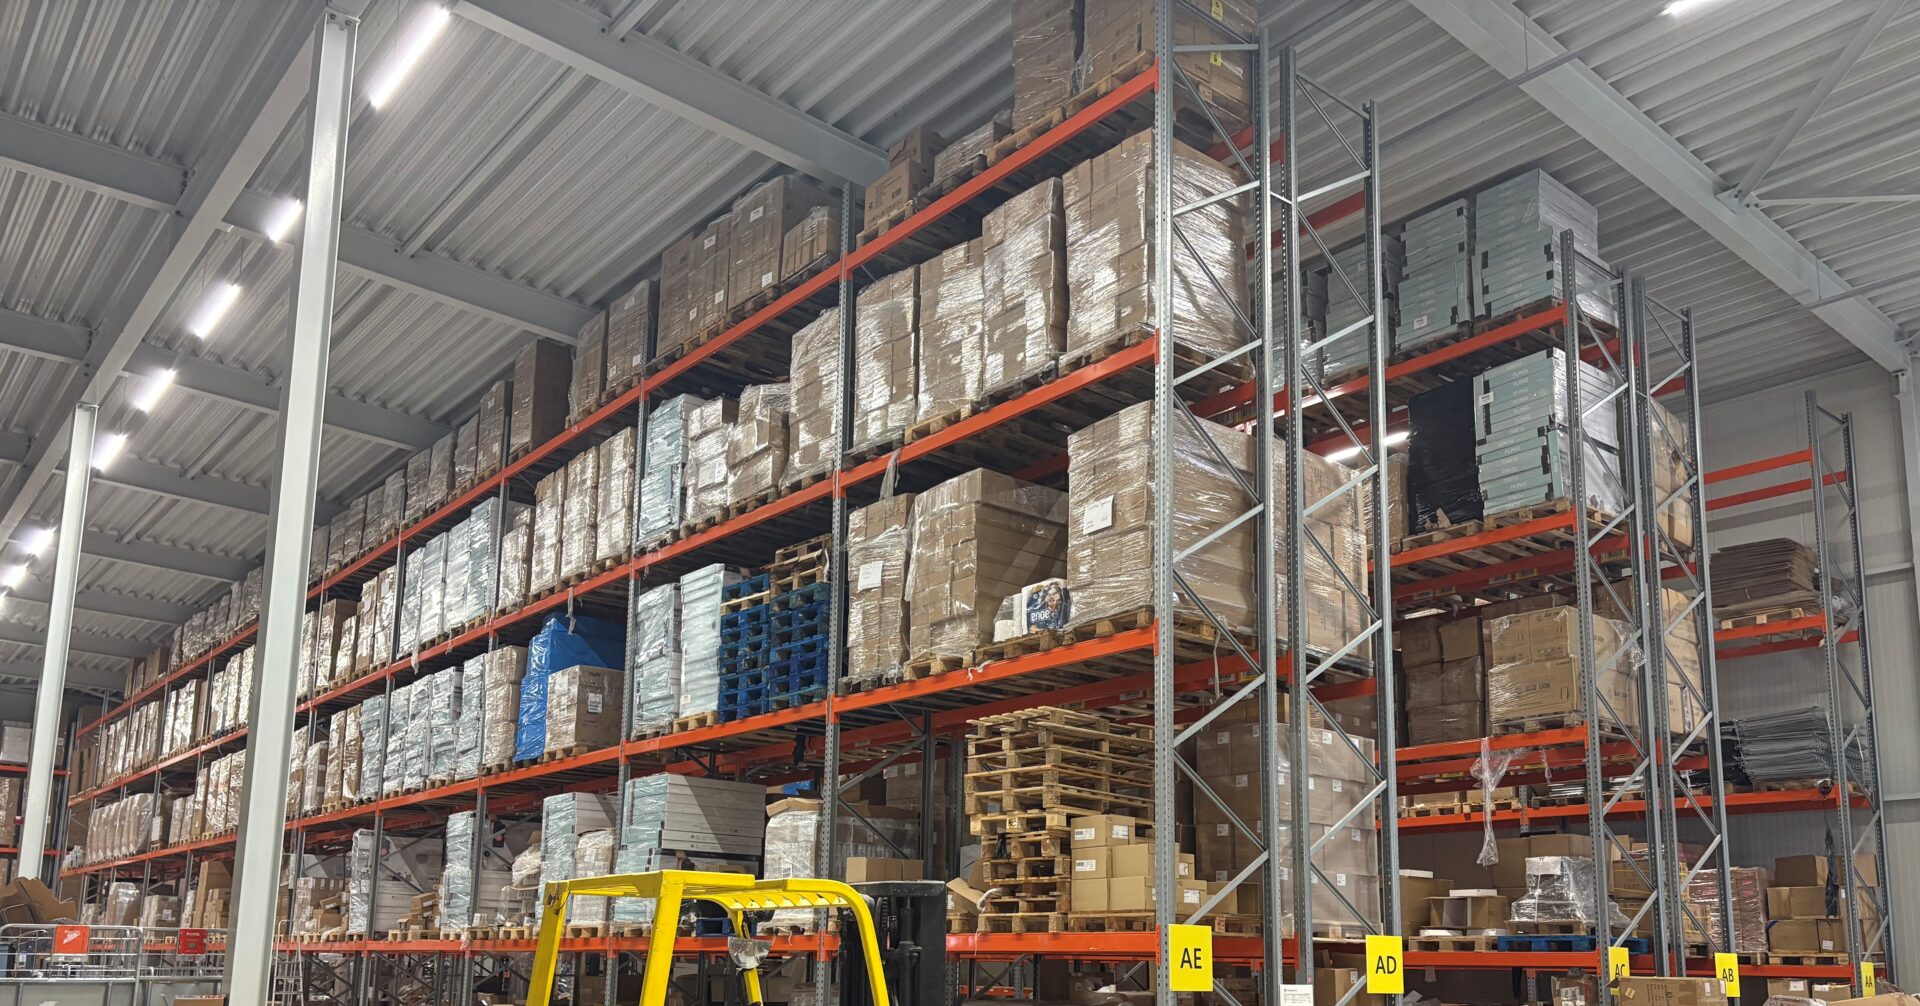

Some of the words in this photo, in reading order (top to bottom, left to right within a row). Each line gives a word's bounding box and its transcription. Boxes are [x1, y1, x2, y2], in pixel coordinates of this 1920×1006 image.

[1180, 947, 1203, 969] AE
[1375, 955, 1397, 974] AD
[1615, 963, 1626, 977] AC
[1722, 968, 1734, 982] AB
[1865, 975, 1873, 988] AA
